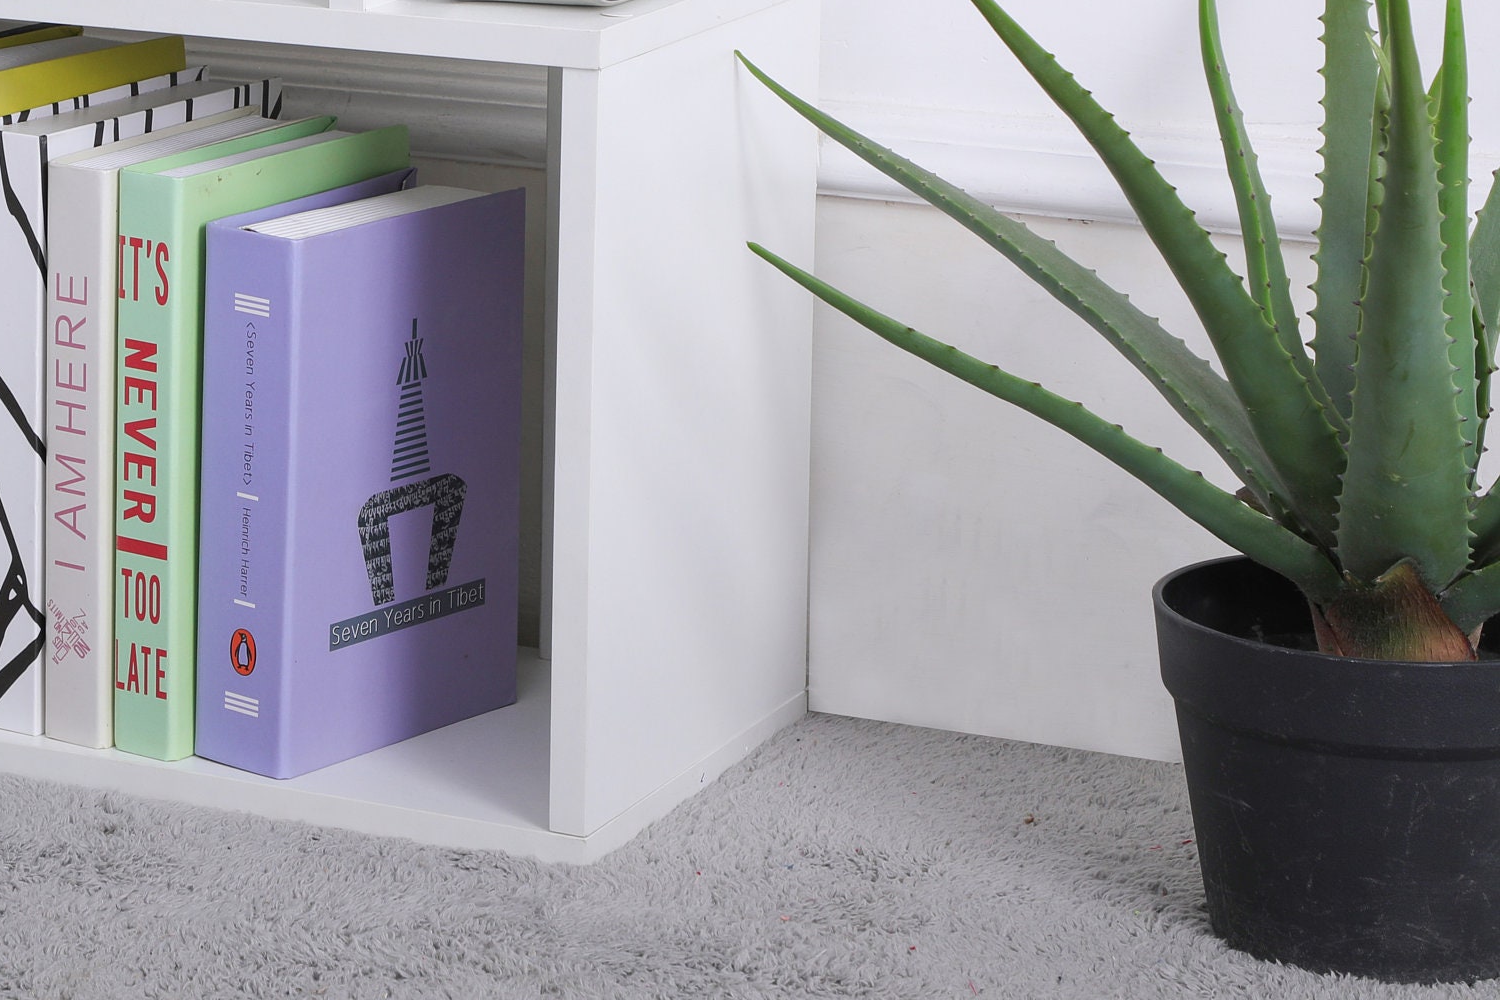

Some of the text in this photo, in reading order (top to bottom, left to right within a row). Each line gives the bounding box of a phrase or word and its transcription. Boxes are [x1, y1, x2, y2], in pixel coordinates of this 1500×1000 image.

[118, 234, 170, 307] IT'S
[55, 272, 88, 436] HERE
[123, 337, 158, 524] NEVER
[244, 381, 256, 421] Years
[244, 424, 254, 436] in
[54, 453, 87, 541] AM
[240, 506, 252, 597] Heinrich Harrer
[121, 567, 161, 625] TOO
[331, 583, 484, 646] Seven Years in Tibet
[115, 638, 168, 700] LATE
